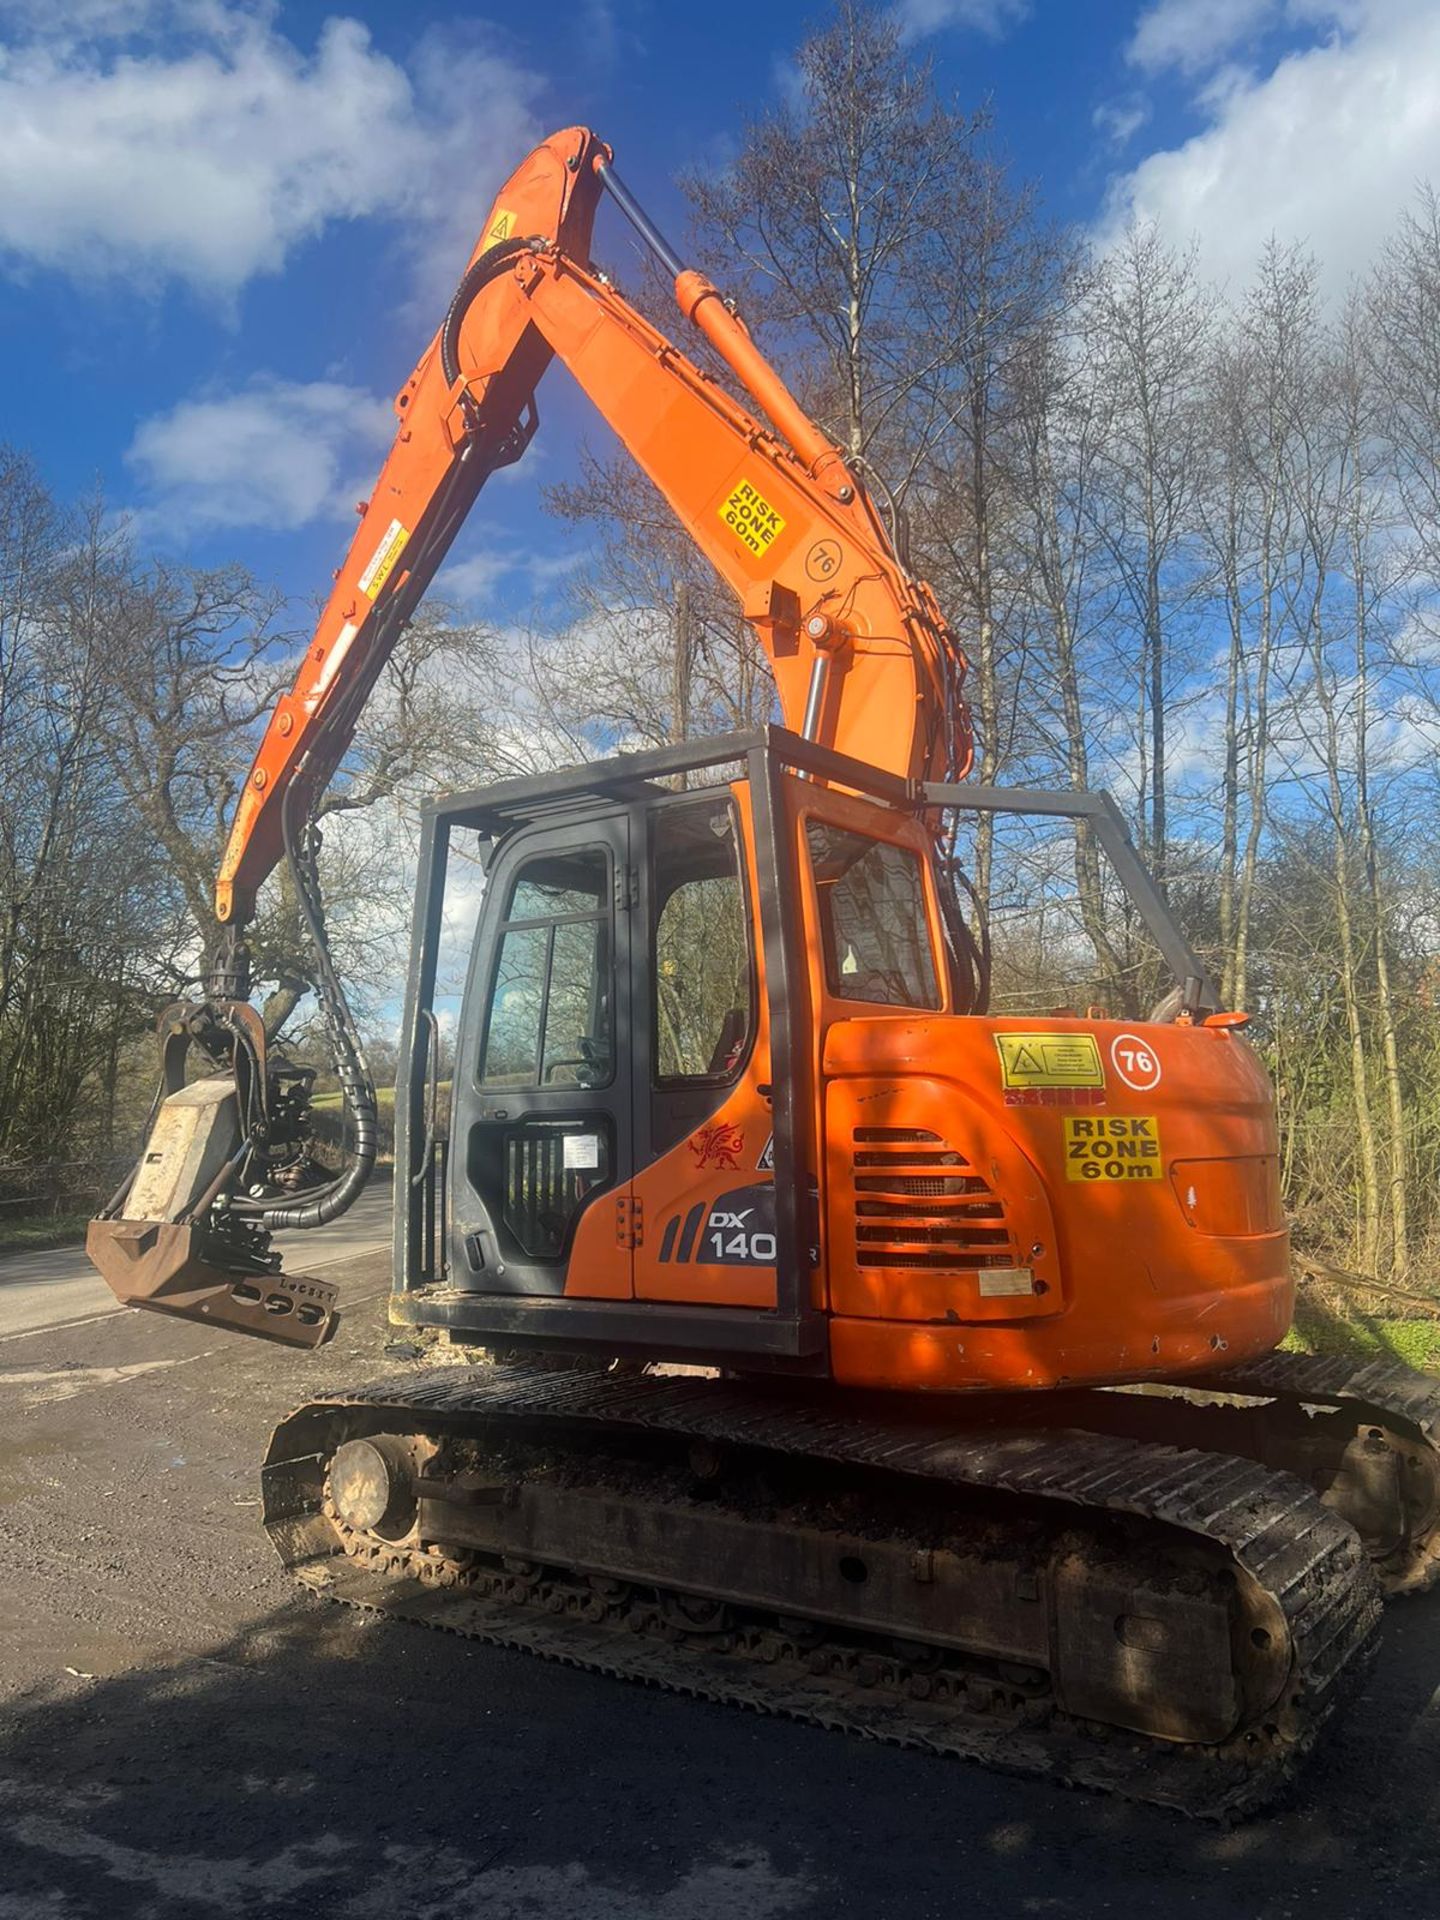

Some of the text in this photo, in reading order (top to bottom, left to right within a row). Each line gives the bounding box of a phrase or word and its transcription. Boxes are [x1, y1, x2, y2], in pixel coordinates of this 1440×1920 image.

[740, 484, 781, 528] RISK
[726, 510, 760, 551] 60m
[728, 493, 774, 545] ZONE
[813, 547, 835, 573] 76
[1119, 1050, 1152, 1072] 76
[1073, 1120, 1150, 1136] RISK
[1069, 1141, 1158, 1158] ZONE
[1081, 1161, 1153, 1179] 60m
[708, 1208, 755, 1228] DX
[710, 1232, 777, 1260] 140
